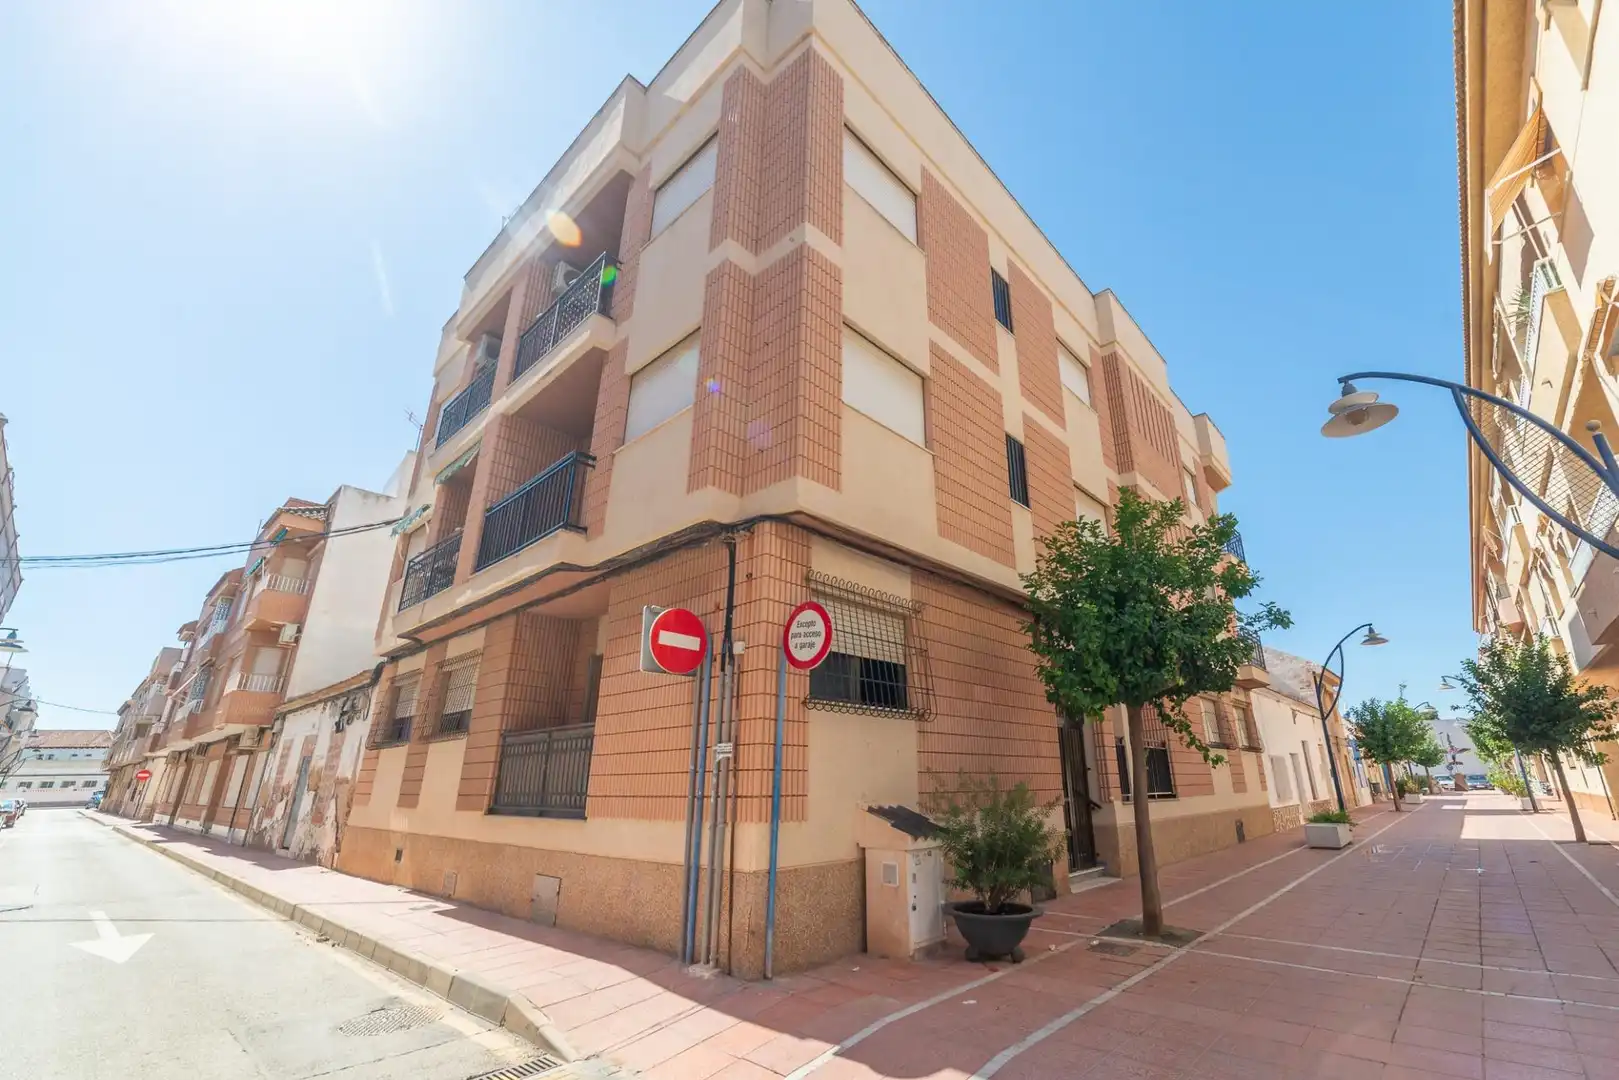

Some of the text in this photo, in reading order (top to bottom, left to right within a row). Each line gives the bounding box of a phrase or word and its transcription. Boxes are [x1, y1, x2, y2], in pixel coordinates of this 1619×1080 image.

[797, 620, 816, 629] Excepto
[791, 630, 821, 640] para acceso
[799, 640, 816, 650] garaje
